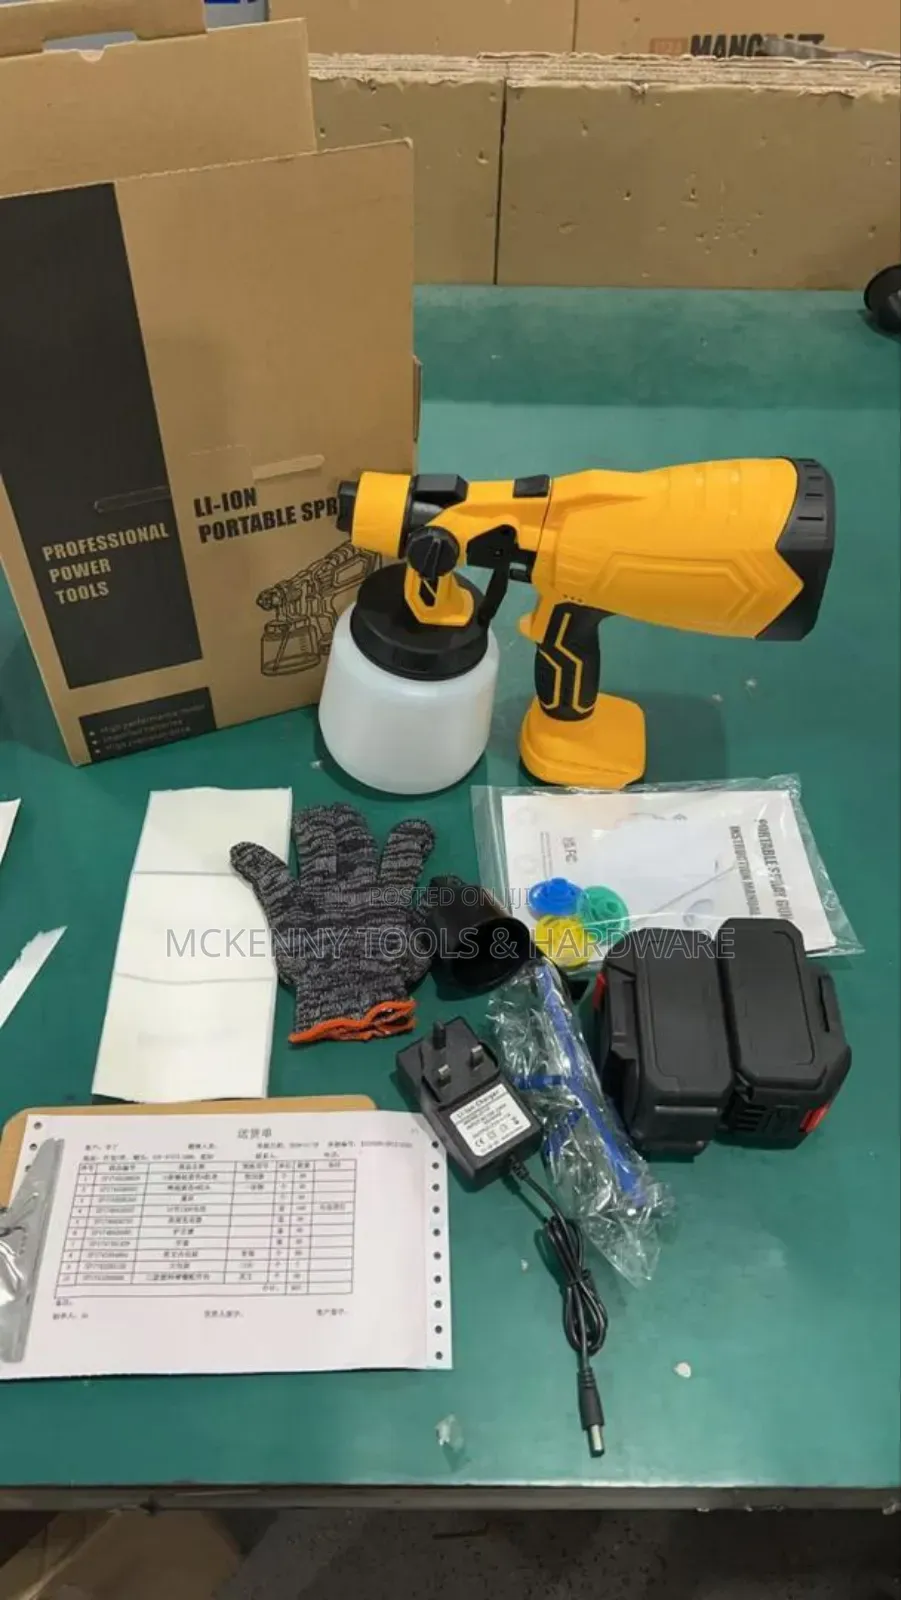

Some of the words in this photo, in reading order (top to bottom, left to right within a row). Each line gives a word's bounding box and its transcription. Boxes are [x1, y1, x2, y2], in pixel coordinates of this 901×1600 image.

[193, 487, 257, 518] LI-ION
[198, 506, 297, 543] PORTABLE
[300, 496, 338, 522] SPR
[42, 522, 169, 562] PROFESSIONAL
[48, 558, 112, 583] POWER
[55, 581, 110, 605] TOOLS
